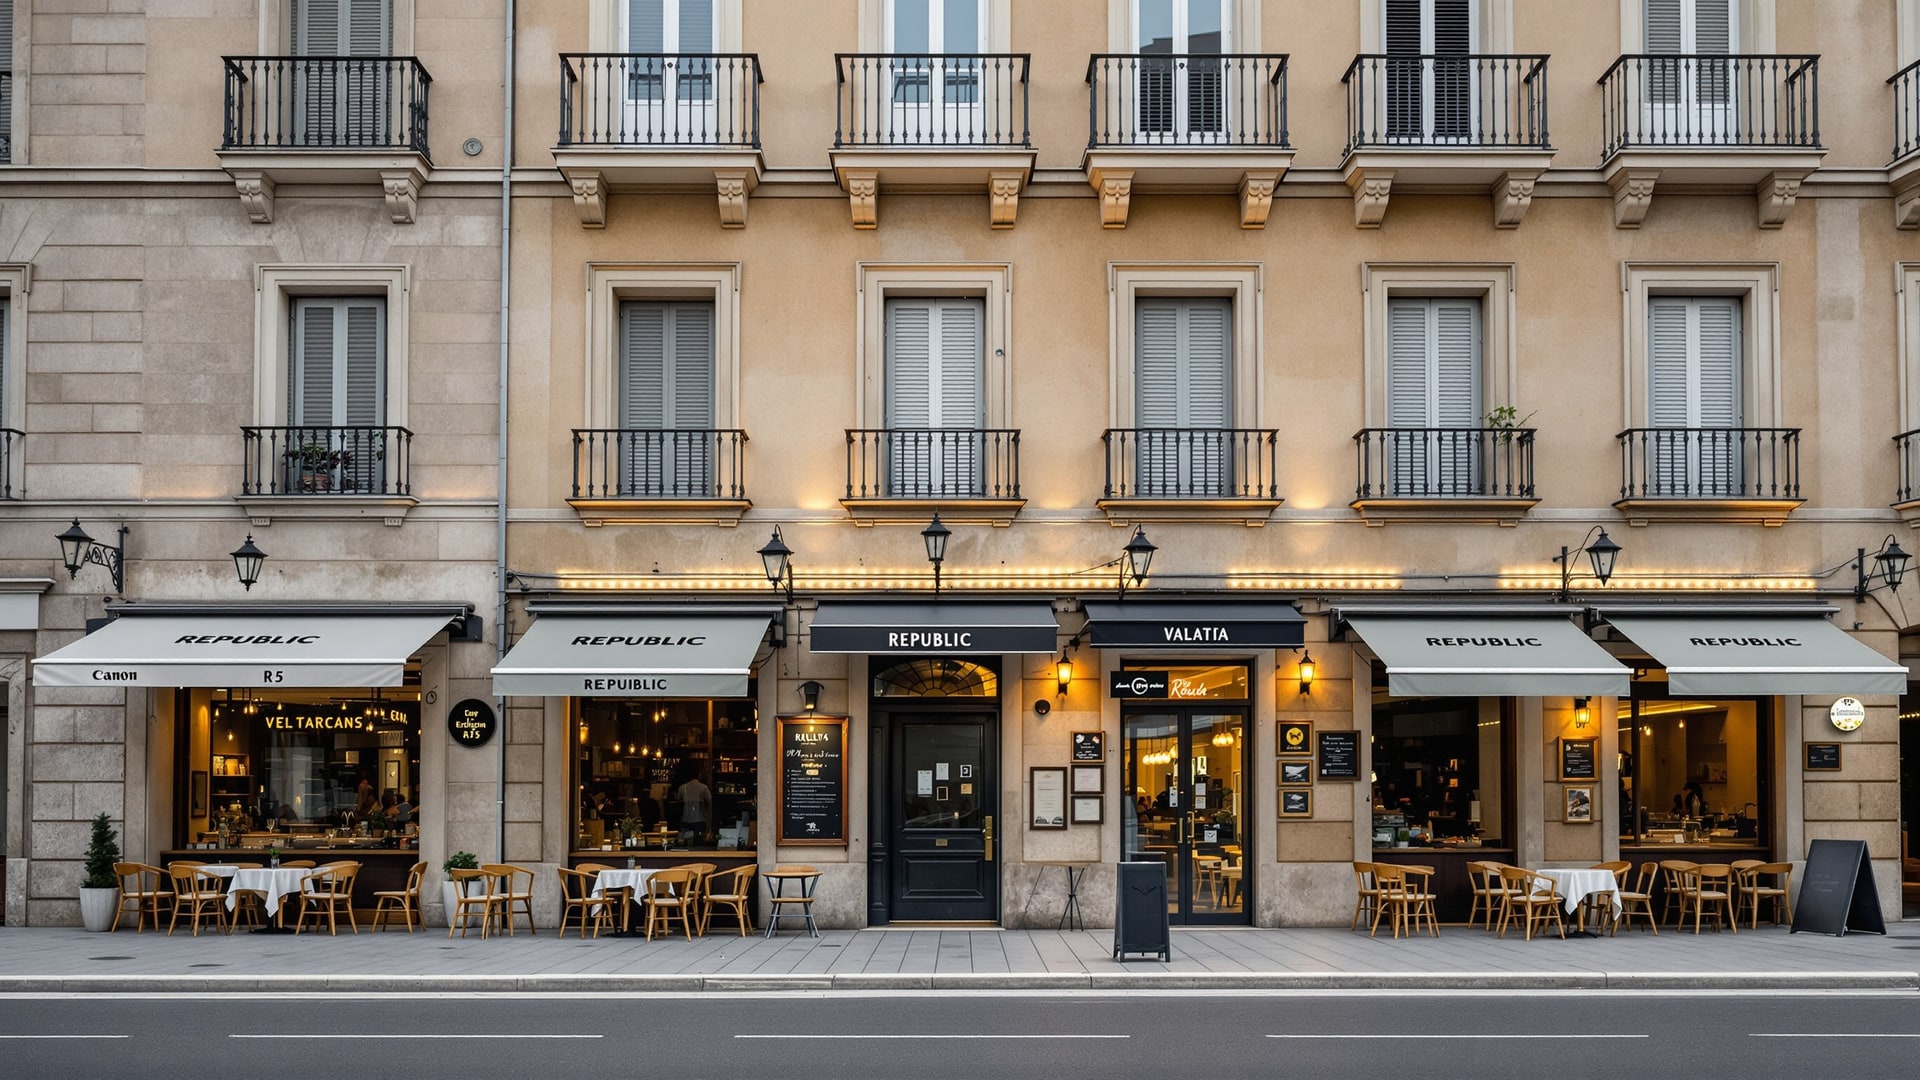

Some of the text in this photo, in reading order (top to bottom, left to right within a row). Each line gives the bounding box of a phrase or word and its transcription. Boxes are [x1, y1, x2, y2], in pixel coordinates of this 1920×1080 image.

[175, 635, 321, 644] REPUBLIC
[571, 636, 707, 646] REPUBLIC
[888, 632, 972, 647] REPUBLIC
[1426, 637, 1543, 647] REPUBLIC
[1689, 637, 1802, 646] REPUBLIC
[92, 669, 137, 681] Canon
[265, 716, 363, 729] VEL TARCANS
